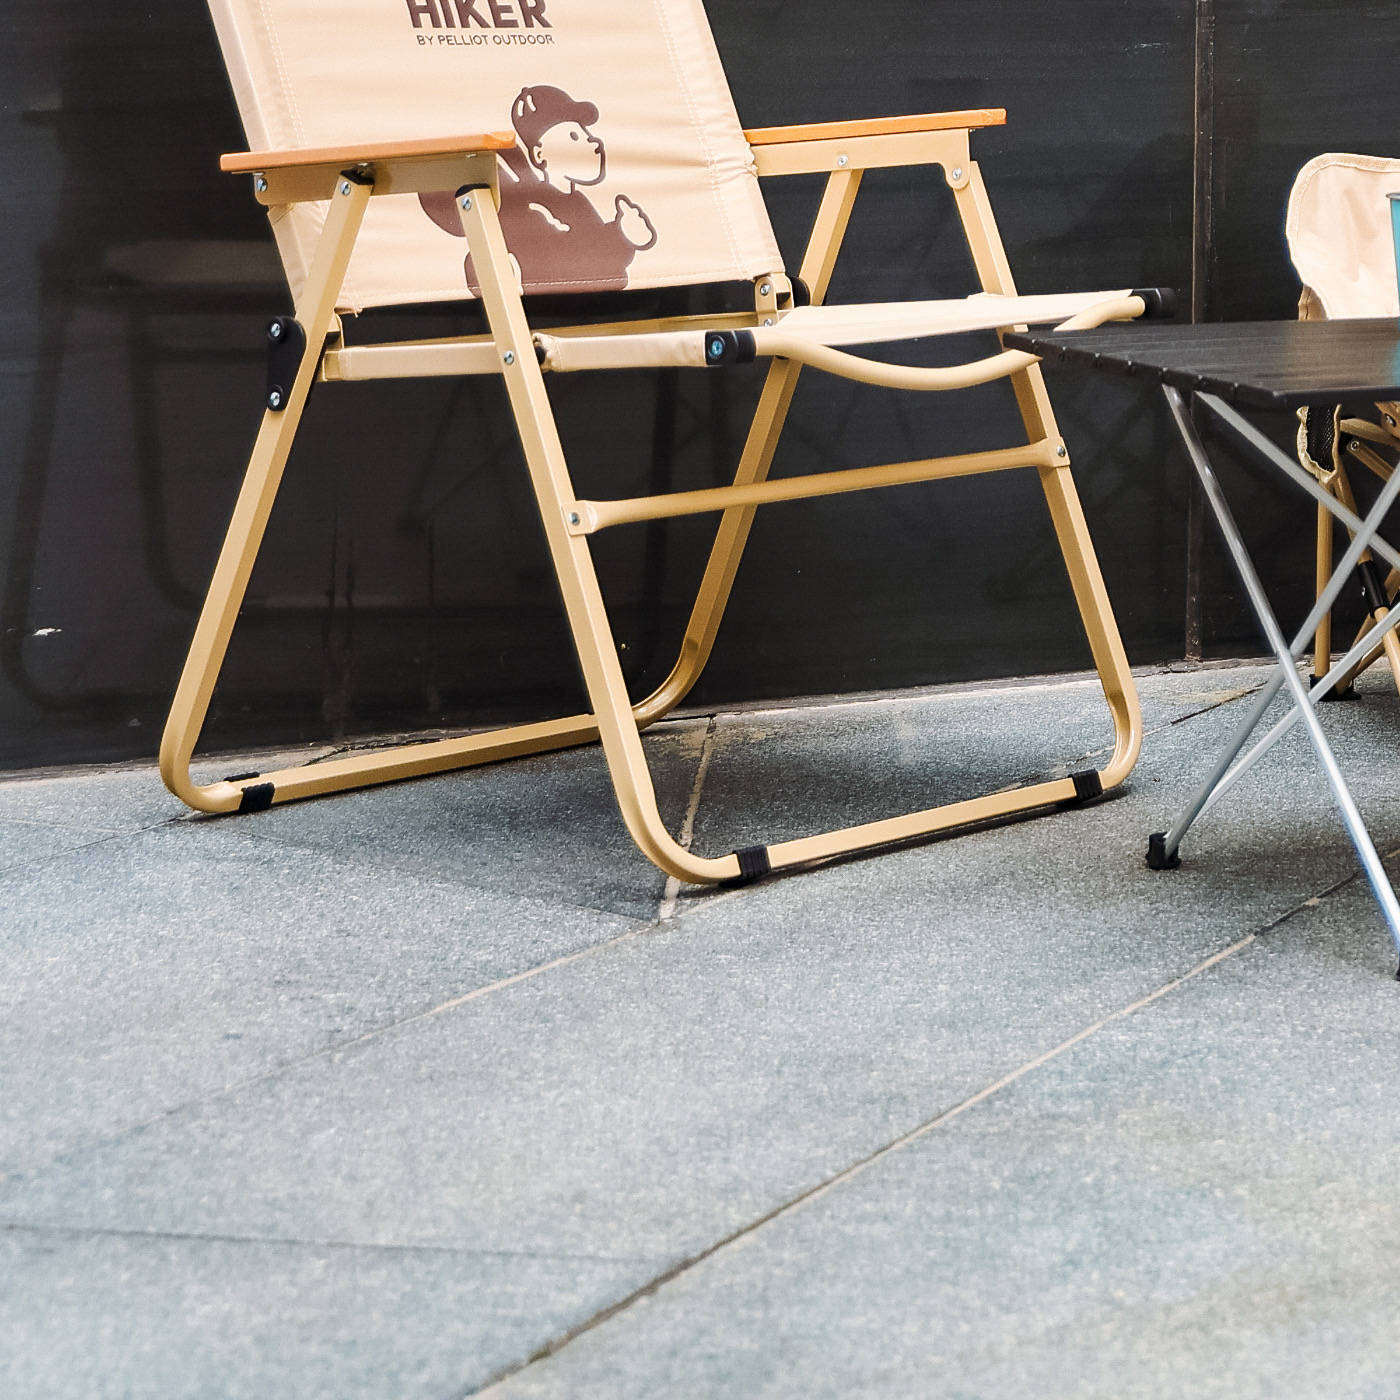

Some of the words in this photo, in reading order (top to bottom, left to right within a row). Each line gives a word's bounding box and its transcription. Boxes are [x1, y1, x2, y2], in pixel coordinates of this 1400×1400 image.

[416, 34, 434, 46] BY
[437, 34, 491, 46] PELLIOT
[492, 33, 555, 45] OUTDOOR
